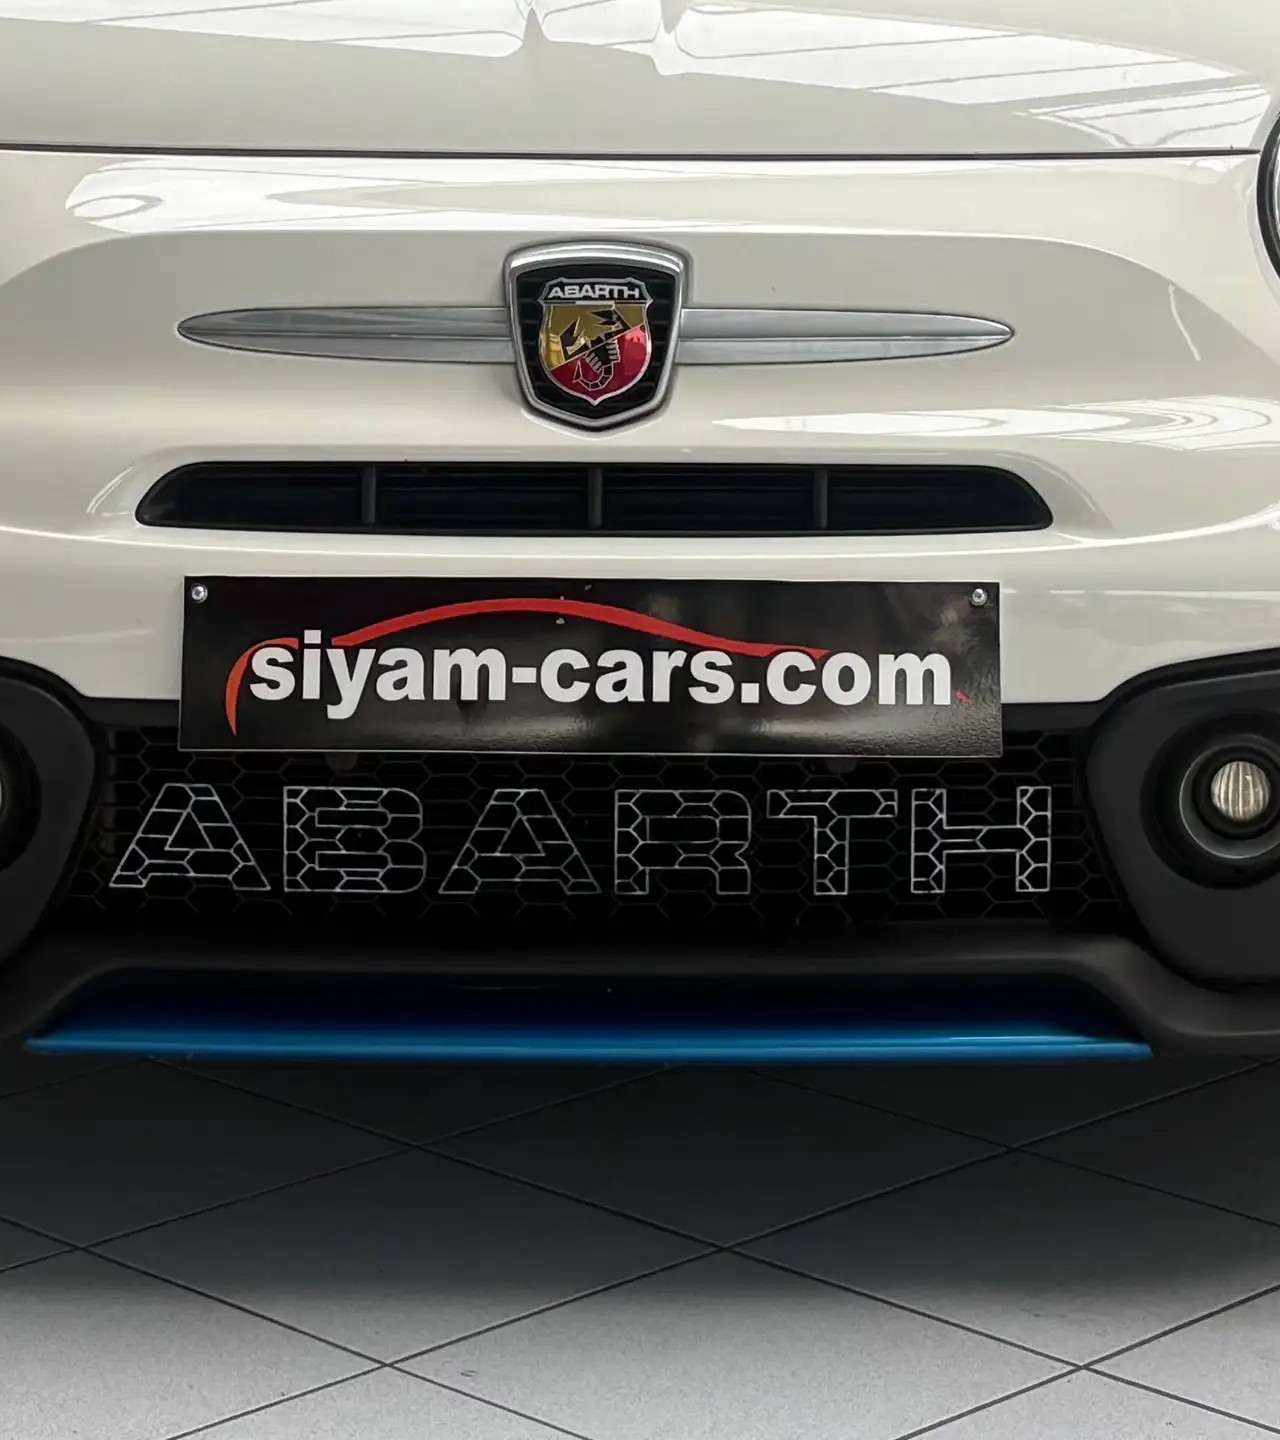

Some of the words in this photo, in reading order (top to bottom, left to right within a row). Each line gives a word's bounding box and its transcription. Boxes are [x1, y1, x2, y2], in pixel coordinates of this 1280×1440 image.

[548, 284, 640, 299] ABARTH
[250, 629, 952, 720] siyam-cars.com
[109, 783, 1052, 895] ABARTH
